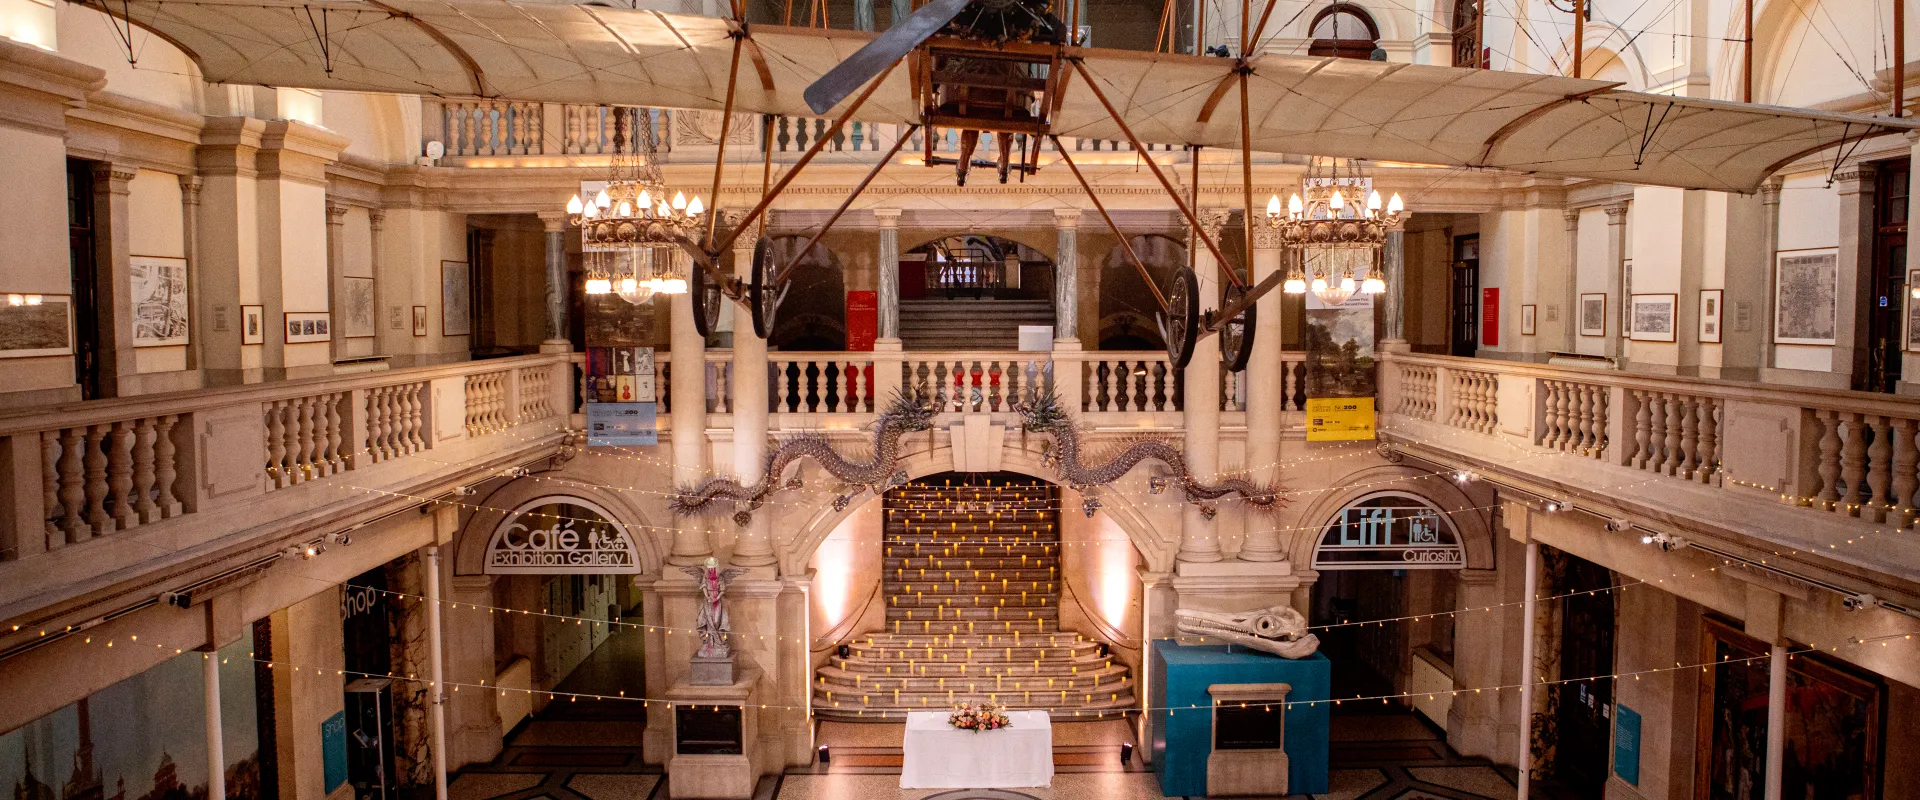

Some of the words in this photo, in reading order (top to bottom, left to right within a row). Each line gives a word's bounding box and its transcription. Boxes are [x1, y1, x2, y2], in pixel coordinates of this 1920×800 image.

[503, 521, 580, 551] Café
[1341, 507, 1396, 545] Lift
[493, 551, 564, 565] Exhibition
[568, 551, 624, 568] Gallery
[1402, 549, 1459, 564] Curiosity
